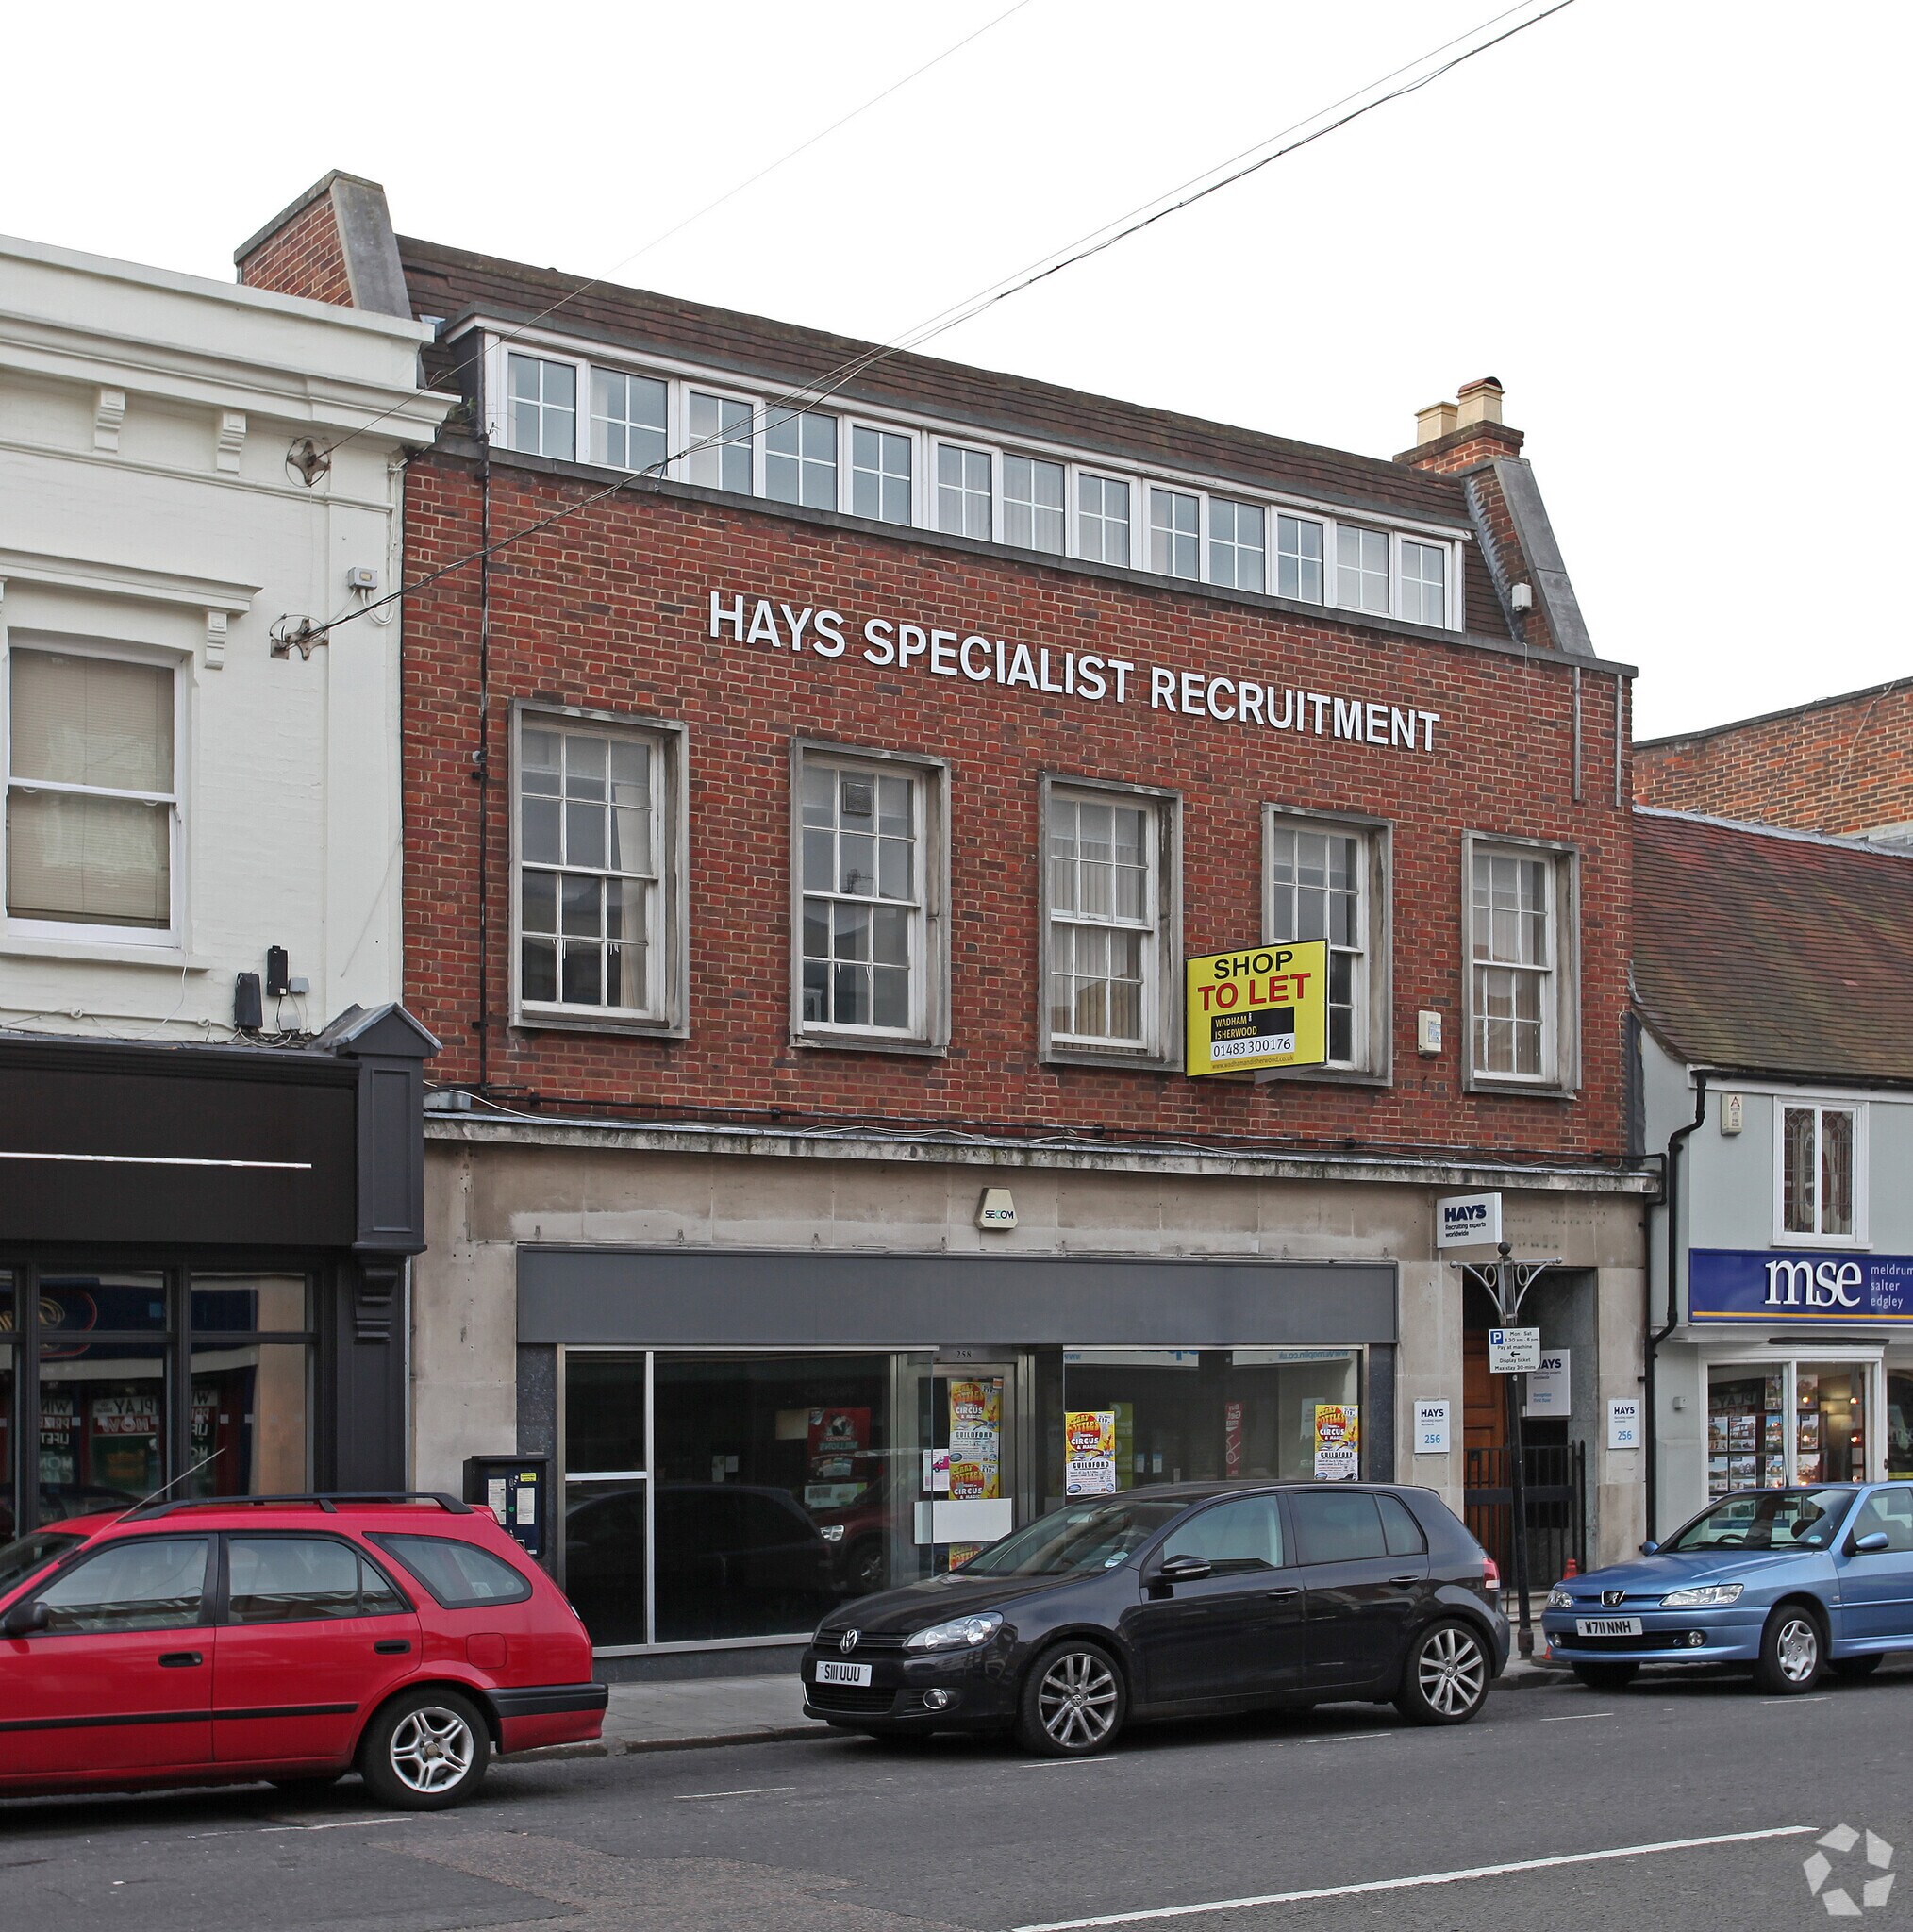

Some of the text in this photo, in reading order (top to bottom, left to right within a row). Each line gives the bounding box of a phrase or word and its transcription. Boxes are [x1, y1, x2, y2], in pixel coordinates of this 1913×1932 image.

[708, 591, 1440, 752] HAYS SPECIALIST RECRUITMENT
[1214, 950, 1293, 979] SHOP
[1198, 973, 1311, 1011] TO LET
[1215, 1015, 1247, 1027] WADHAM
[1215, 1026, 1257, 1040] ISHERWOOD
[1213, 1038, 1291, 1057] 01483 300176
[1212, 1056, 1294, 1069] www.wadhamandisherwood.co.uk
[985, 1210, 1014, 1220] SECOM
[1444, 1204, 1487, 1223] HAYS
[1871, 1264, 1913, 1275] meldrum
[1765, 1260, 1862, 1307] mse
[1871, 1279, 1900, 1291] salter
[1871, 1294, 1904, 1309] edgley
[1493, 1332, 1502, 1344] P
[956, 1350, 972, 1358] 258
[1421, 1408, 1444, 1417] HAYS
[1424, 1435, 1440, 1443] 256
[1618, 1431, 1632, 1440] 256
[1585, 1621, 1631, 1634] W711 NNH
[824, 1664, 860, 1682] S111 UUU
